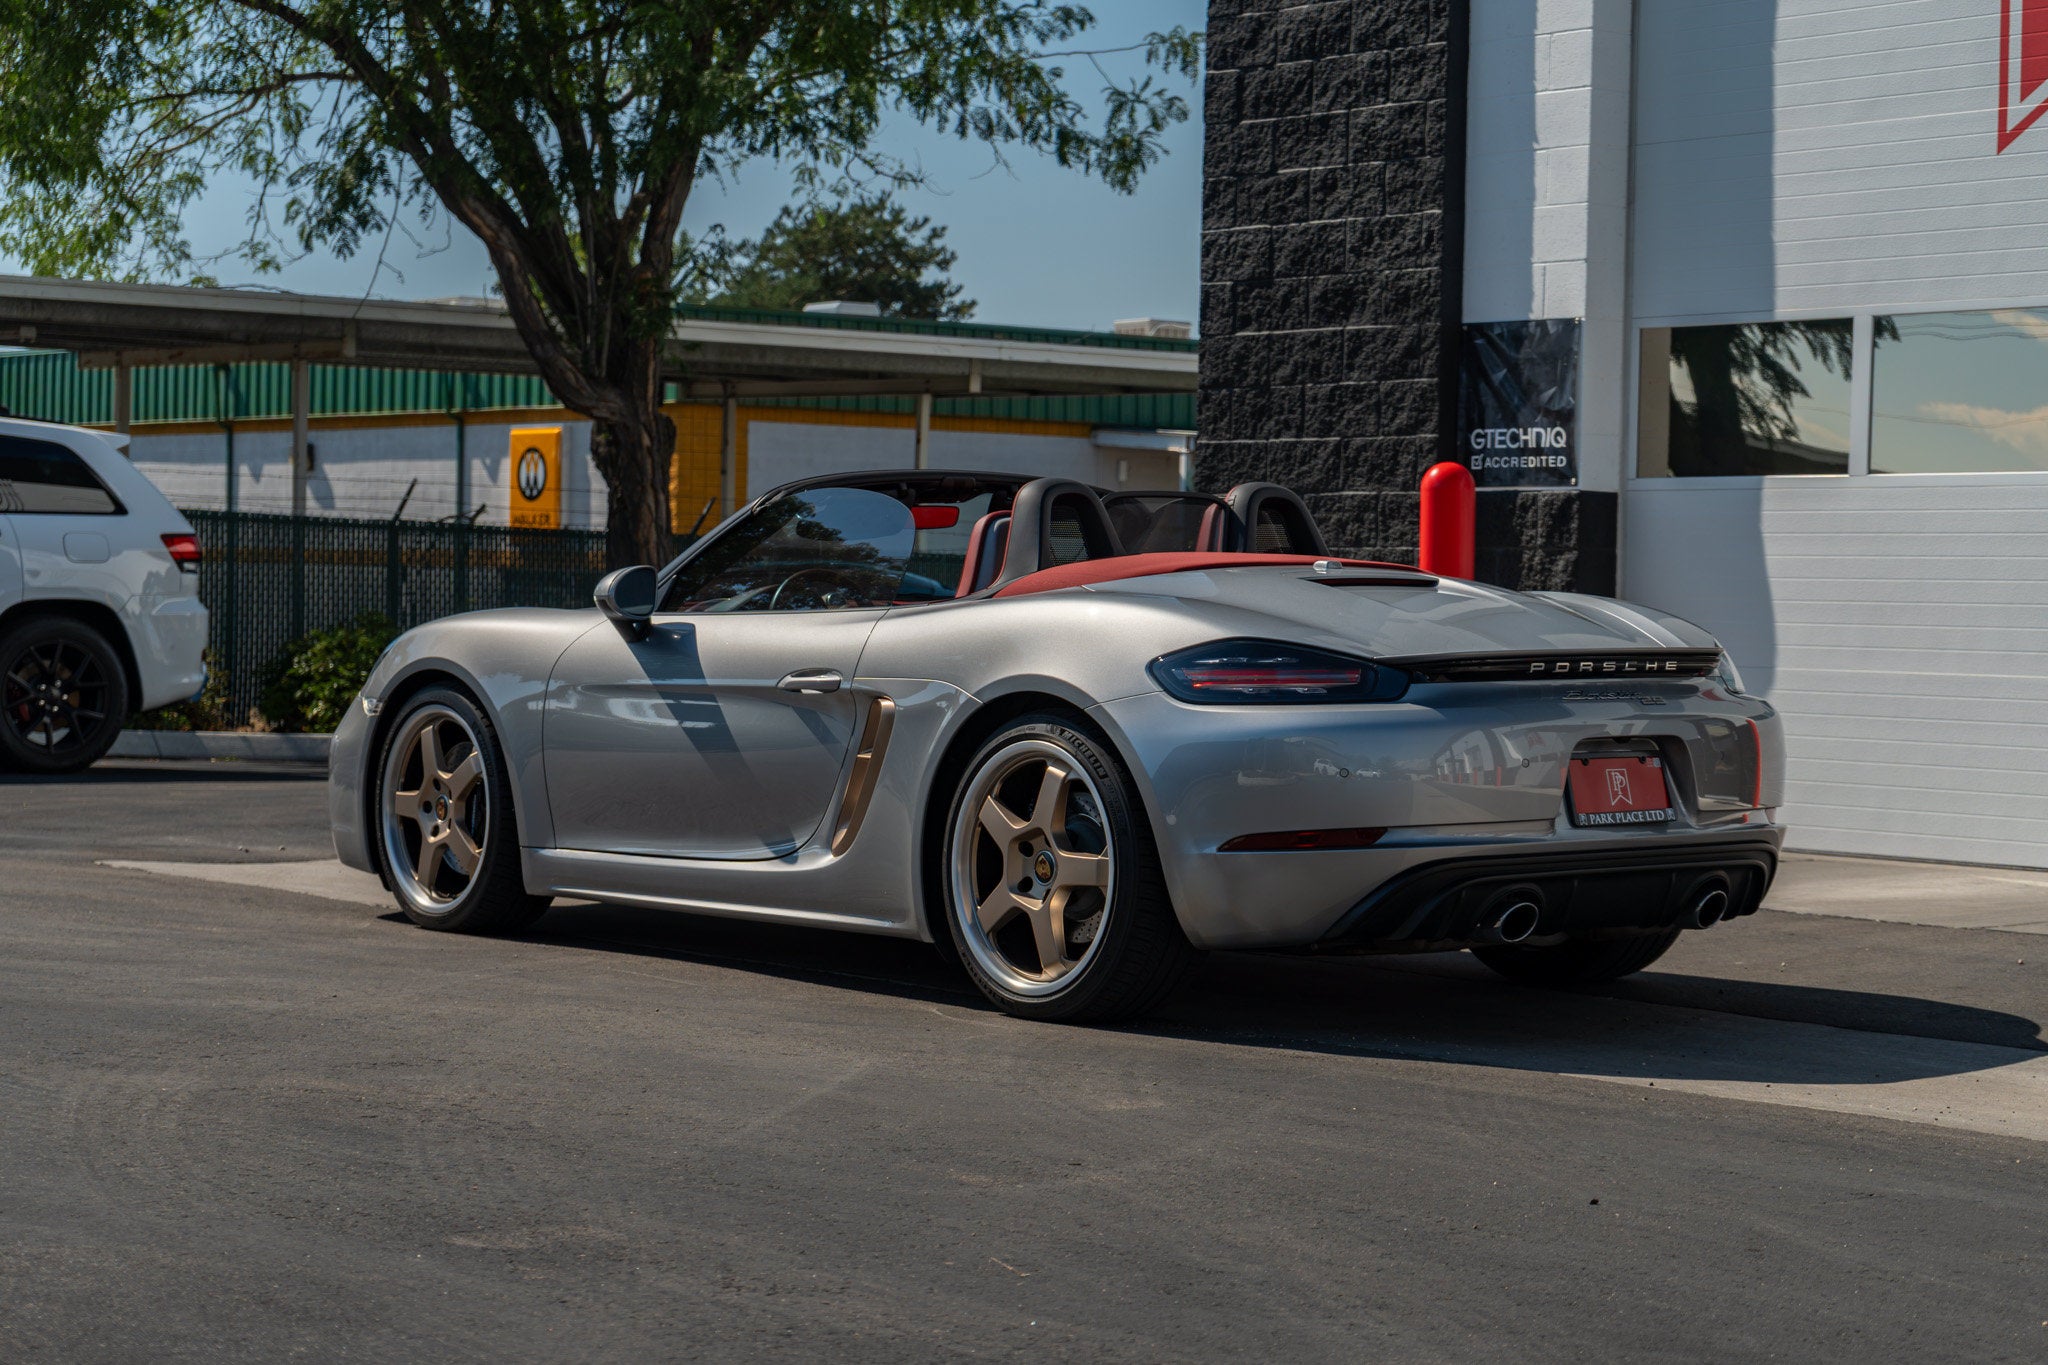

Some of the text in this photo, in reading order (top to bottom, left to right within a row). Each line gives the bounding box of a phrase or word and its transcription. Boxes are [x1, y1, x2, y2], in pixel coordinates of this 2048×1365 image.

[1484, 456, 1567, 468] ACCREDITED
[1529, 661, 1678, 673] PORSCHE
[1063, 732, 1106, 777] MICHELIN
[1589, 809, 1665, 825] PARK PLACE LTD
